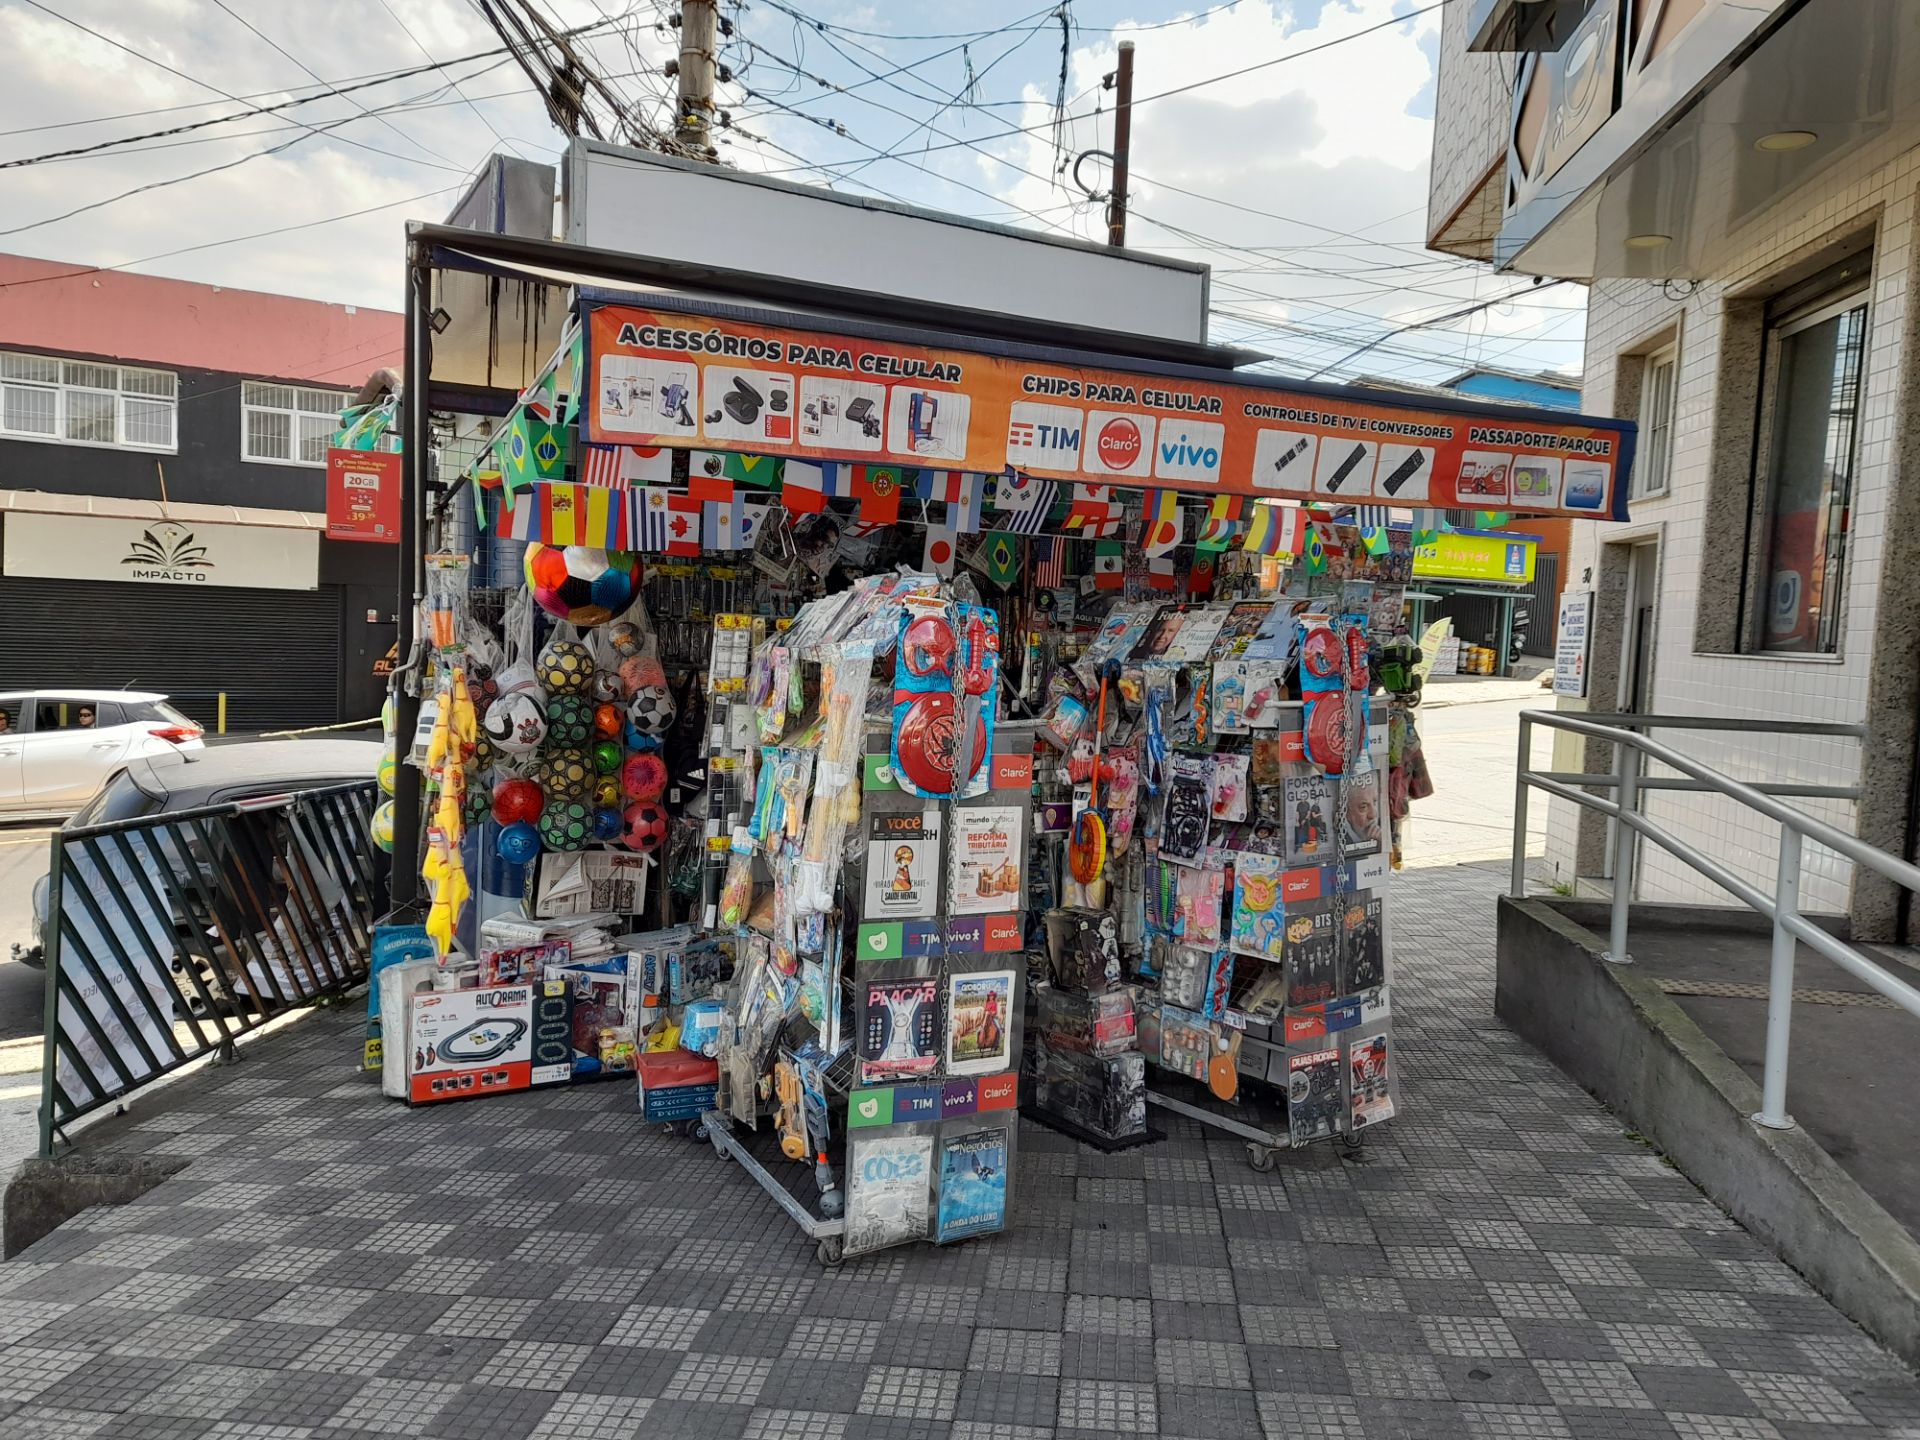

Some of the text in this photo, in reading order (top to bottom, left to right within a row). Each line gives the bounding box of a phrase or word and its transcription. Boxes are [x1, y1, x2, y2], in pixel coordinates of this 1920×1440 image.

[618, 324, 961, 382] ACESSÓRIOS PARA CELULAR
[1023, 375, 1222, 414] CHIPS PARA CELULAR
[1243, 403, 1454, 439] CONTROLES DE TV E CONVERSORES
[1038, 425, 1080, 451] TIM
[1101, 435, 1135, 451] Claro
[1470, 428, 1611, 455] PASSAPORTE PARQUE
[1161, 434, 1219, 469] vivo
[132, 570, 206, 581] IMPACTO
[1000, 767, 1026, 779] Claro
[1350, 773, 1373, 788] veja
[1287, 776, 1325, 790] FORÇA
[1287, 788, 1332, 802] GLOBAL
[966, 816, 990, 824] mundo
[967, 832, 1008, 841] REFORMA
[967, 841, 1008, 849] TRIBUTÁRIA
[1287, 881, 1307, 892] Claro
[1367, 900, 1381, 915] BTS
[1315, 913, 1332, 928] BTS
[920, 933, 941, 944] TIM
[949, 929, 971, 942] vivo
[991, 927, 1017, 939] Claro
[475, 989, 527, 1008] AUTORAMA
[868, 987, 937, 1007] PLACAR
[1292, 1020, 1312, 1031] Claro
[1341, 1008, 1355, 1019] TIM
[912, 1098, 933, 1110] TIM
[944, 1093, 966, 1107] vivo
[984, 1086, 1009, 1099] Claro
